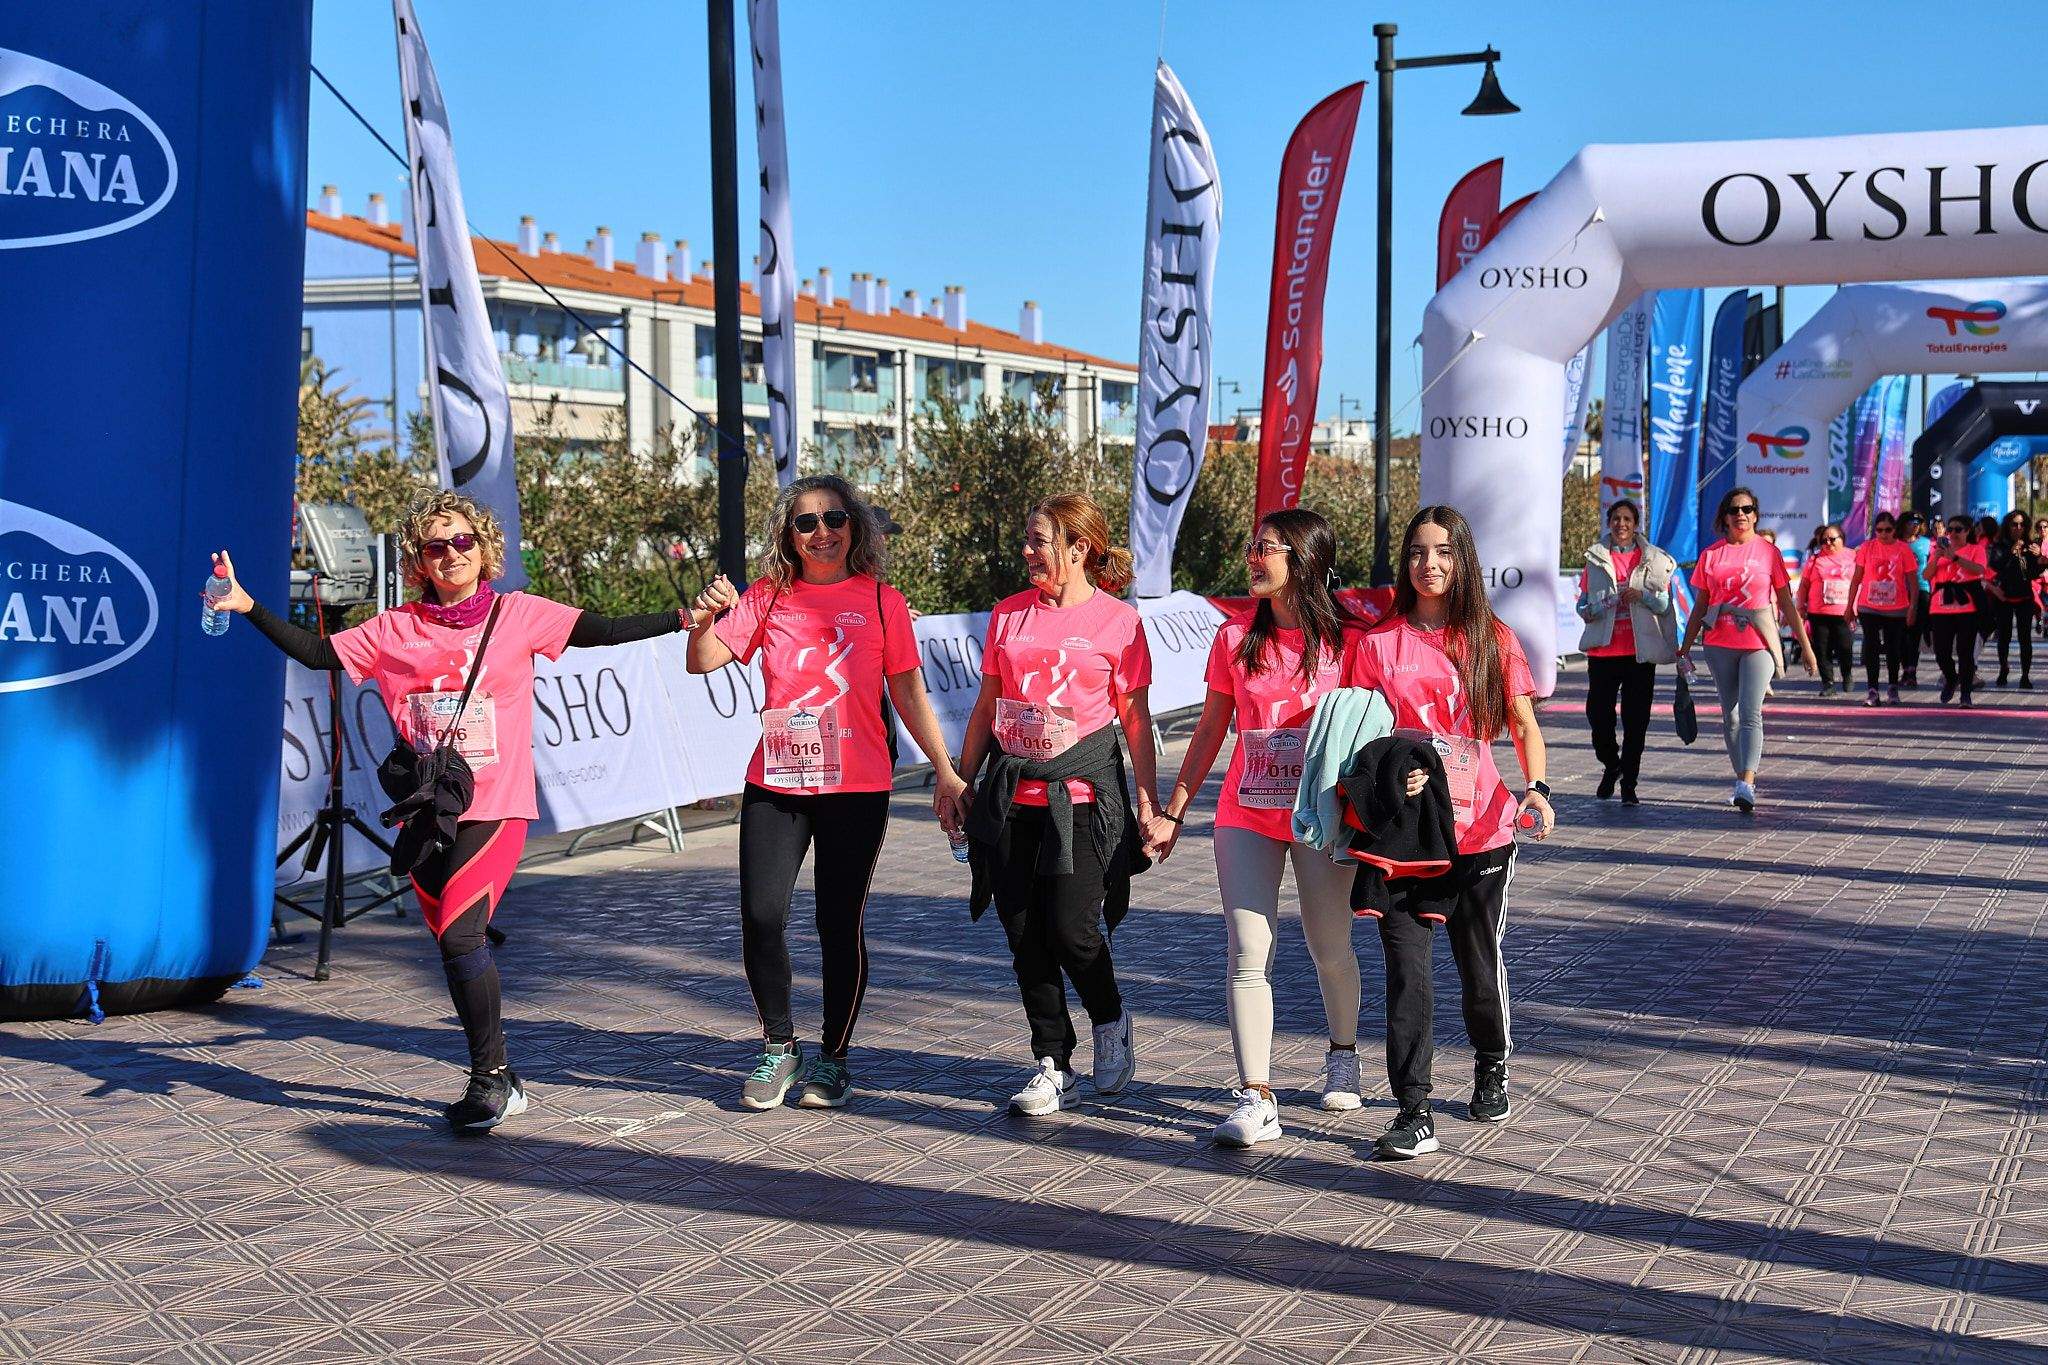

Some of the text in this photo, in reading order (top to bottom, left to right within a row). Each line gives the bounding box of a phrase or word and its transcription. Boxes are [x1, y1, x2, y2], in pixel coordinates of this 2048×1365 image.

[1282, 150, 1332, 350] Santander
[1479, 266, 1588, 290] OYSHO
[1926, 341, 2008, 354] TotalEnergies
[1652, 344, 1700, 455] Marlene
[1430, 416, 1528, 439] OYSHO
[1746, 464, 1810, 476] TotalEnergies
[0, 561, 112, 584] CHERA
[1383, 663, 1419, 676] OSHO
[791, 742, 821, 757] 016
[1022, 736, 1053, 750] 016
[1268, 764, 1302, 778] 016
